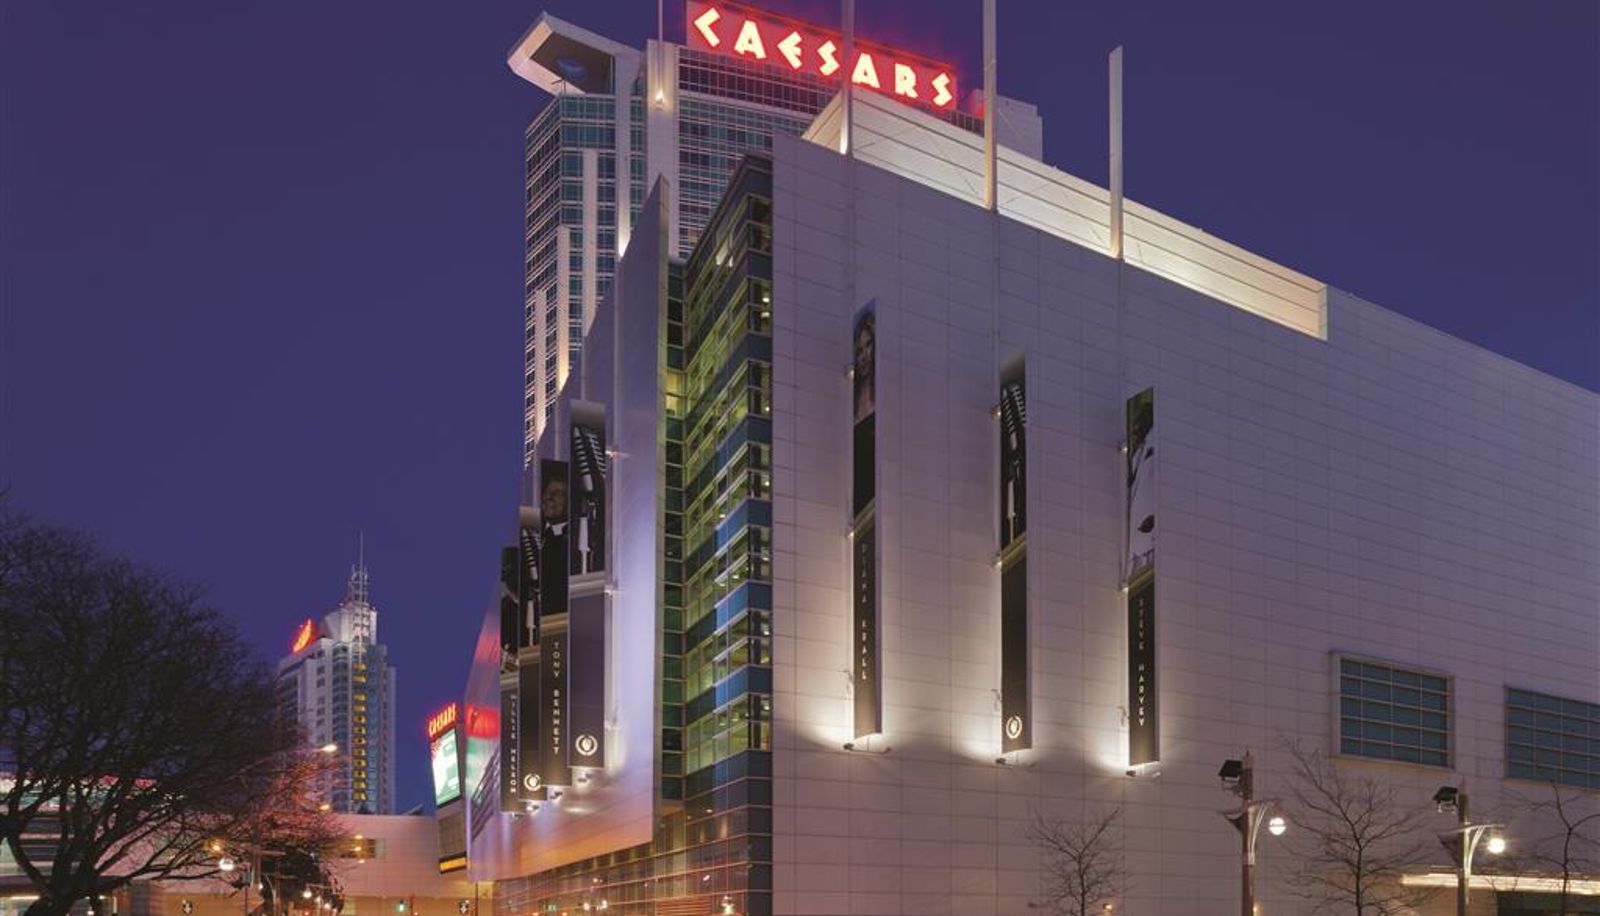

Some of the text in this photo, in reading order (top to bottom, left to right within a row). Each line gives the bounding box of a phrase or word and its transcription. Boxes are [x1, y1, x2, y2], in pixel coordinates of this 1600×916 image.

[694, 7, 953, 107] CAESARS
[552, 641, 561, 755] TONY BENNETT
